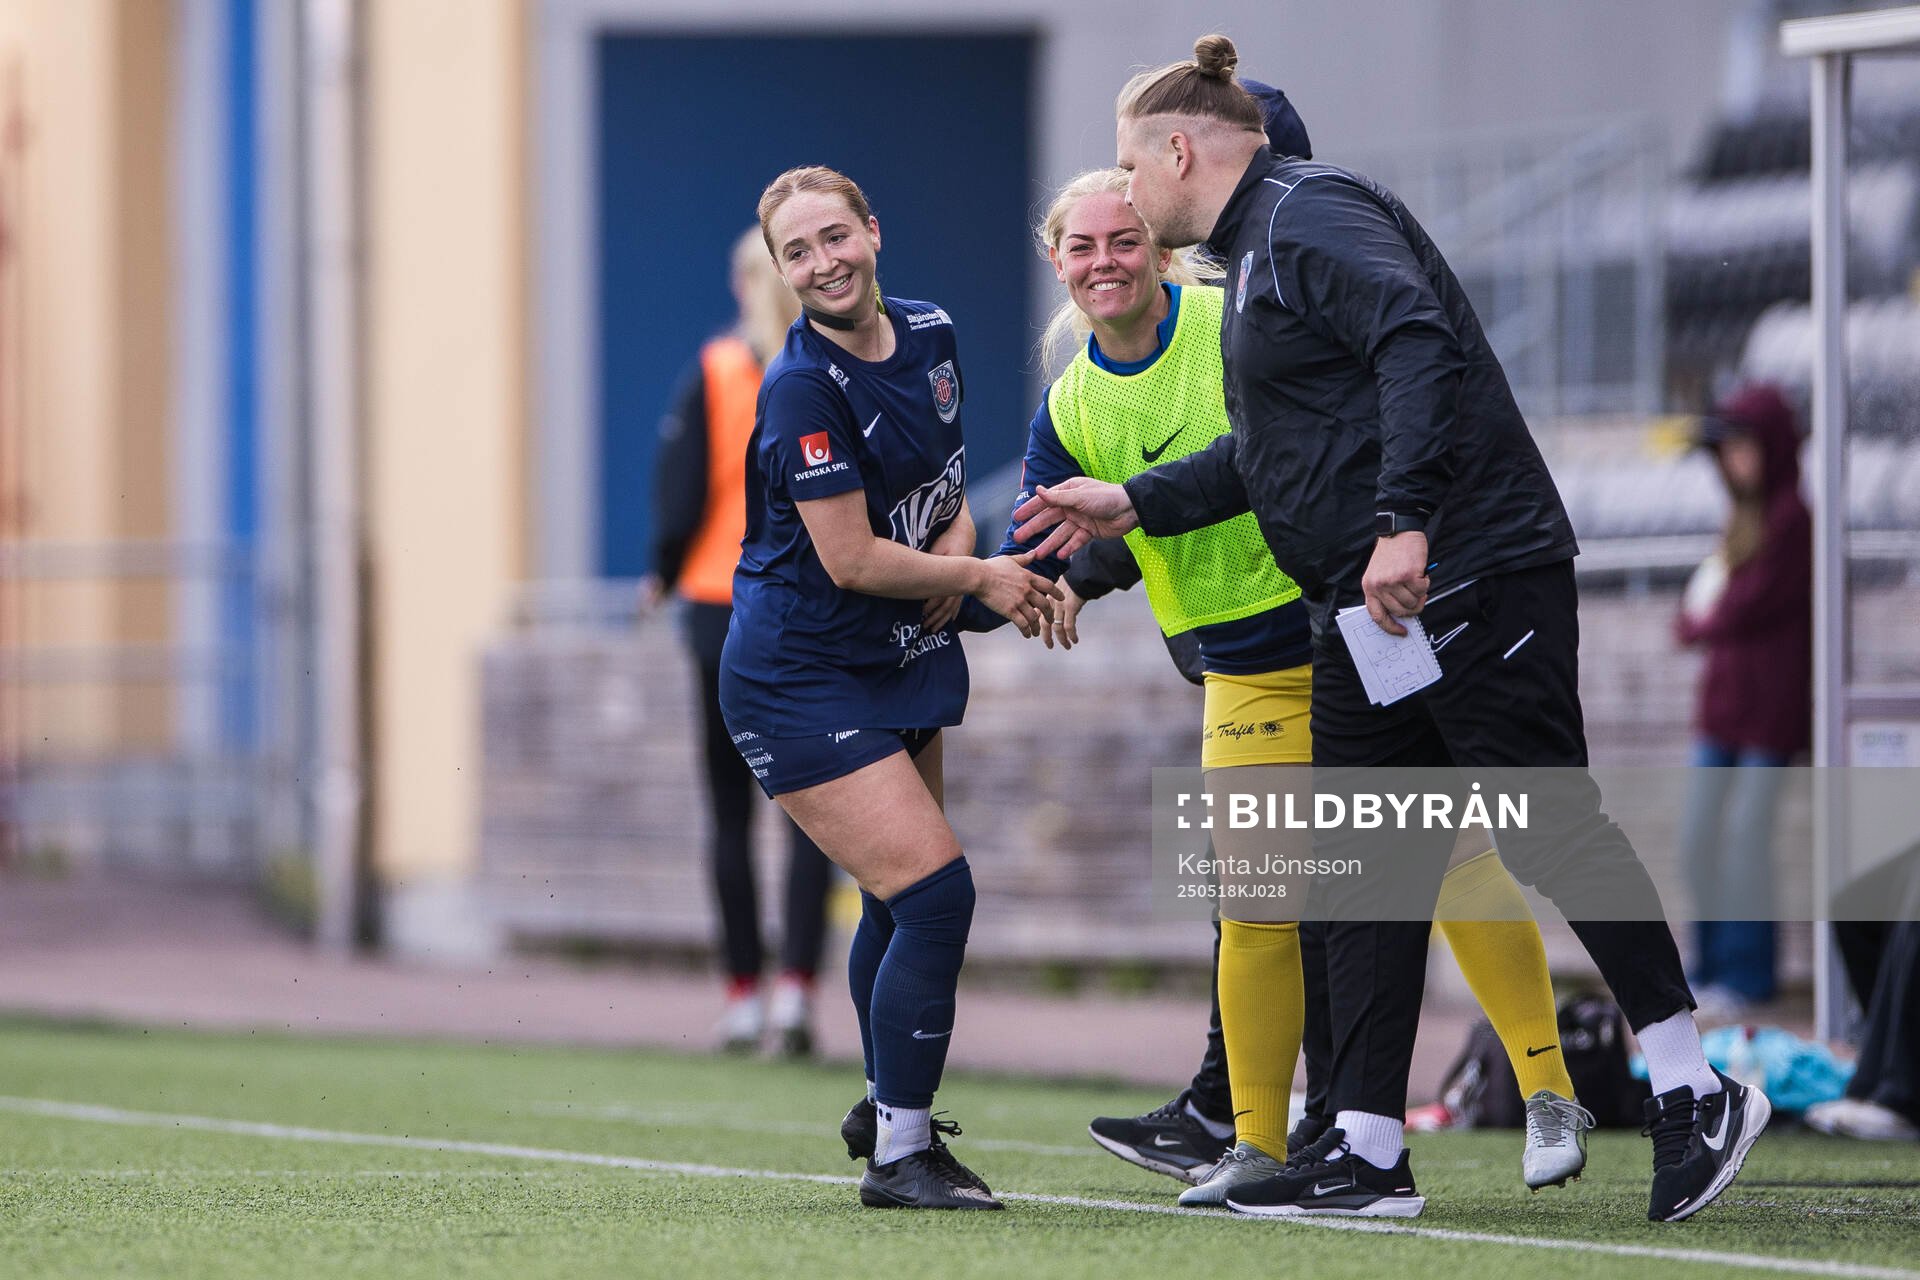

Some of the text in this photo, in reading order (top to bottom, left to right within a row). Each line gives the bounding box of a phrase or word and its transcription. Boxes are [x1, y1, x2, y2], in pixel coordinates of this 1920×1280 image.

[795, 462, 849, 481] SVENSKA SPEL
[1217, 721, 1256, 740] Trafik
